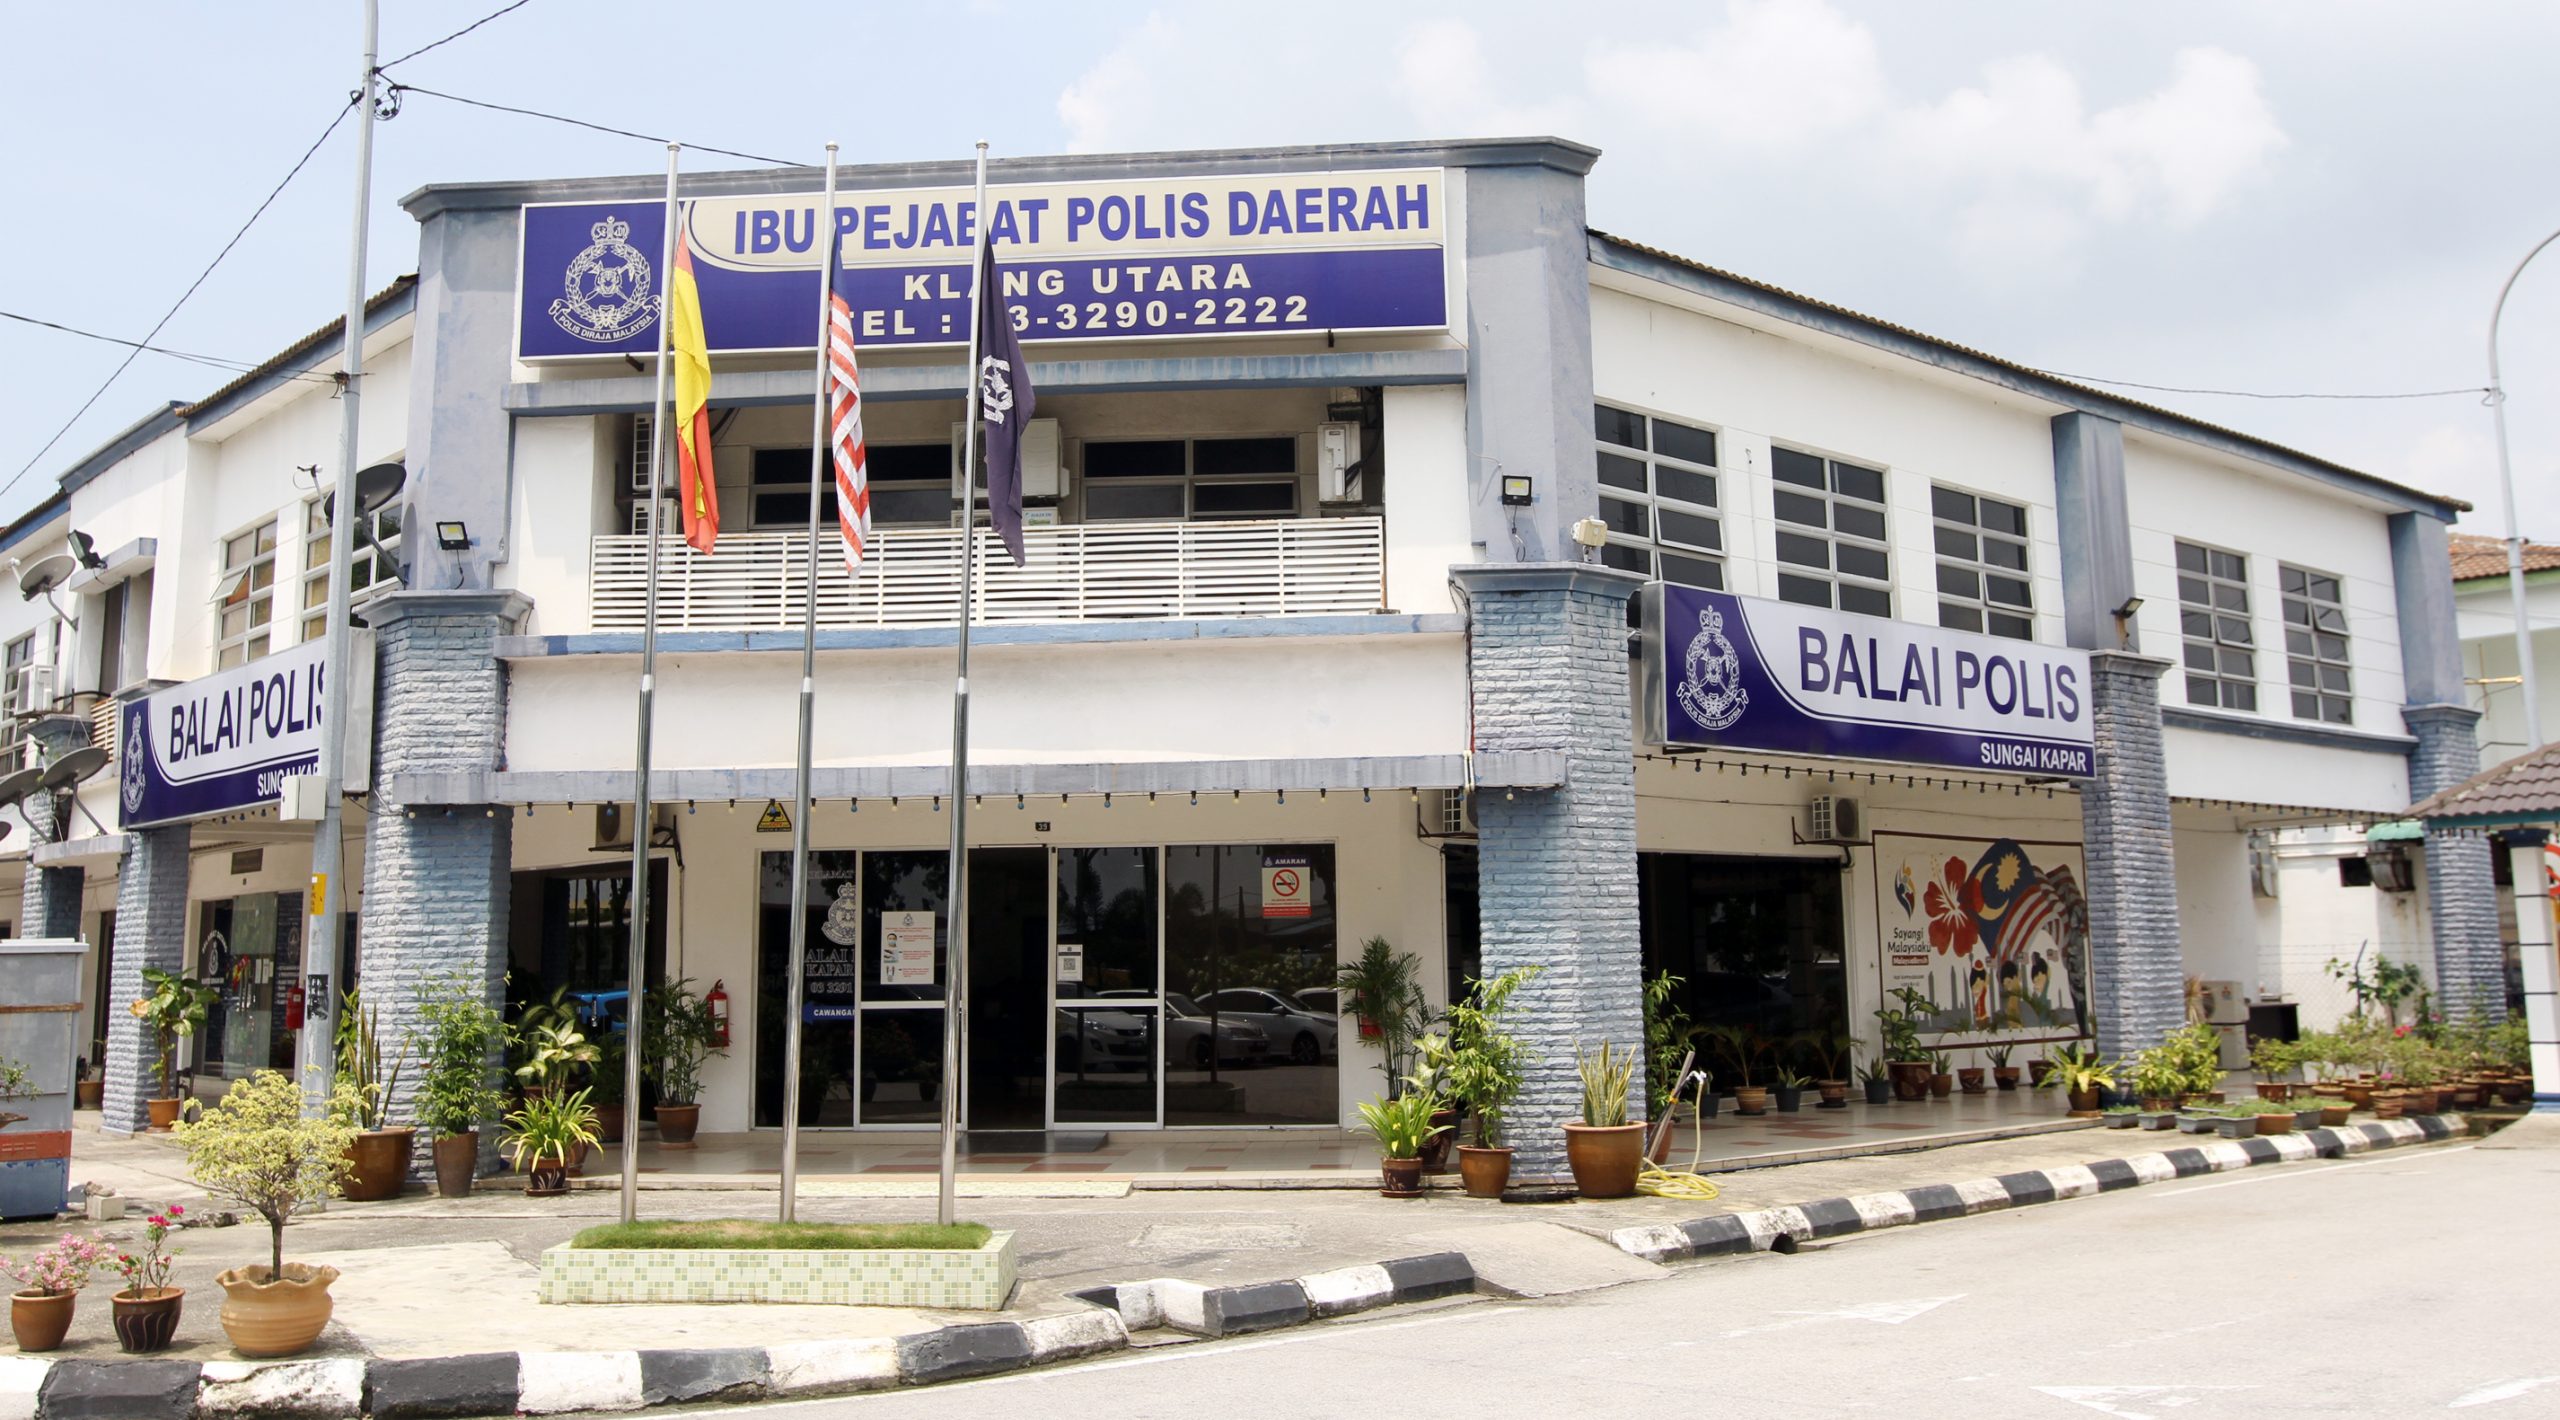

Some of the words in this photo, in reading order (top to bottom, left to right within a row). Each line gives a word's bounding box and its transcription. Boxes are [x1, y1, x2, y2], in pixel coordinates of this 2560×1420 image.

[735, 208, 815, 255] IBU
[833, 198, 1049, 250] PEJABAT
[1067, 192, 1210, 242] POLIS
[1228, 184, 1430, 236] DAERAH
[904, 269, 1065, 301] KLNG
[1092, 263, 1252, 294] UTARA
[558, 315, 579, 334] POLIS
[581, 330, 612, 340] DIRAJA
[613, 315, 653, 339] MALAYSIA
[849, 309, 915, 336] EL
[1008, 295, 1308, 332] 3-3290-2222
[1798, 625, 1942, 707] BALAI
[1956, 650, 2080, 723] POLIS
[170, 686, 243, 763] BALAI
[1980, 742, 2037, 768] SUNGAI
[2040, 748, 2087, 772] KAPAR
[1887, 941, 1931, 954] Malaysiaku
[1893, 927, 1924, 941] Sayangi
[804, 948, 848, 963] ALAI
